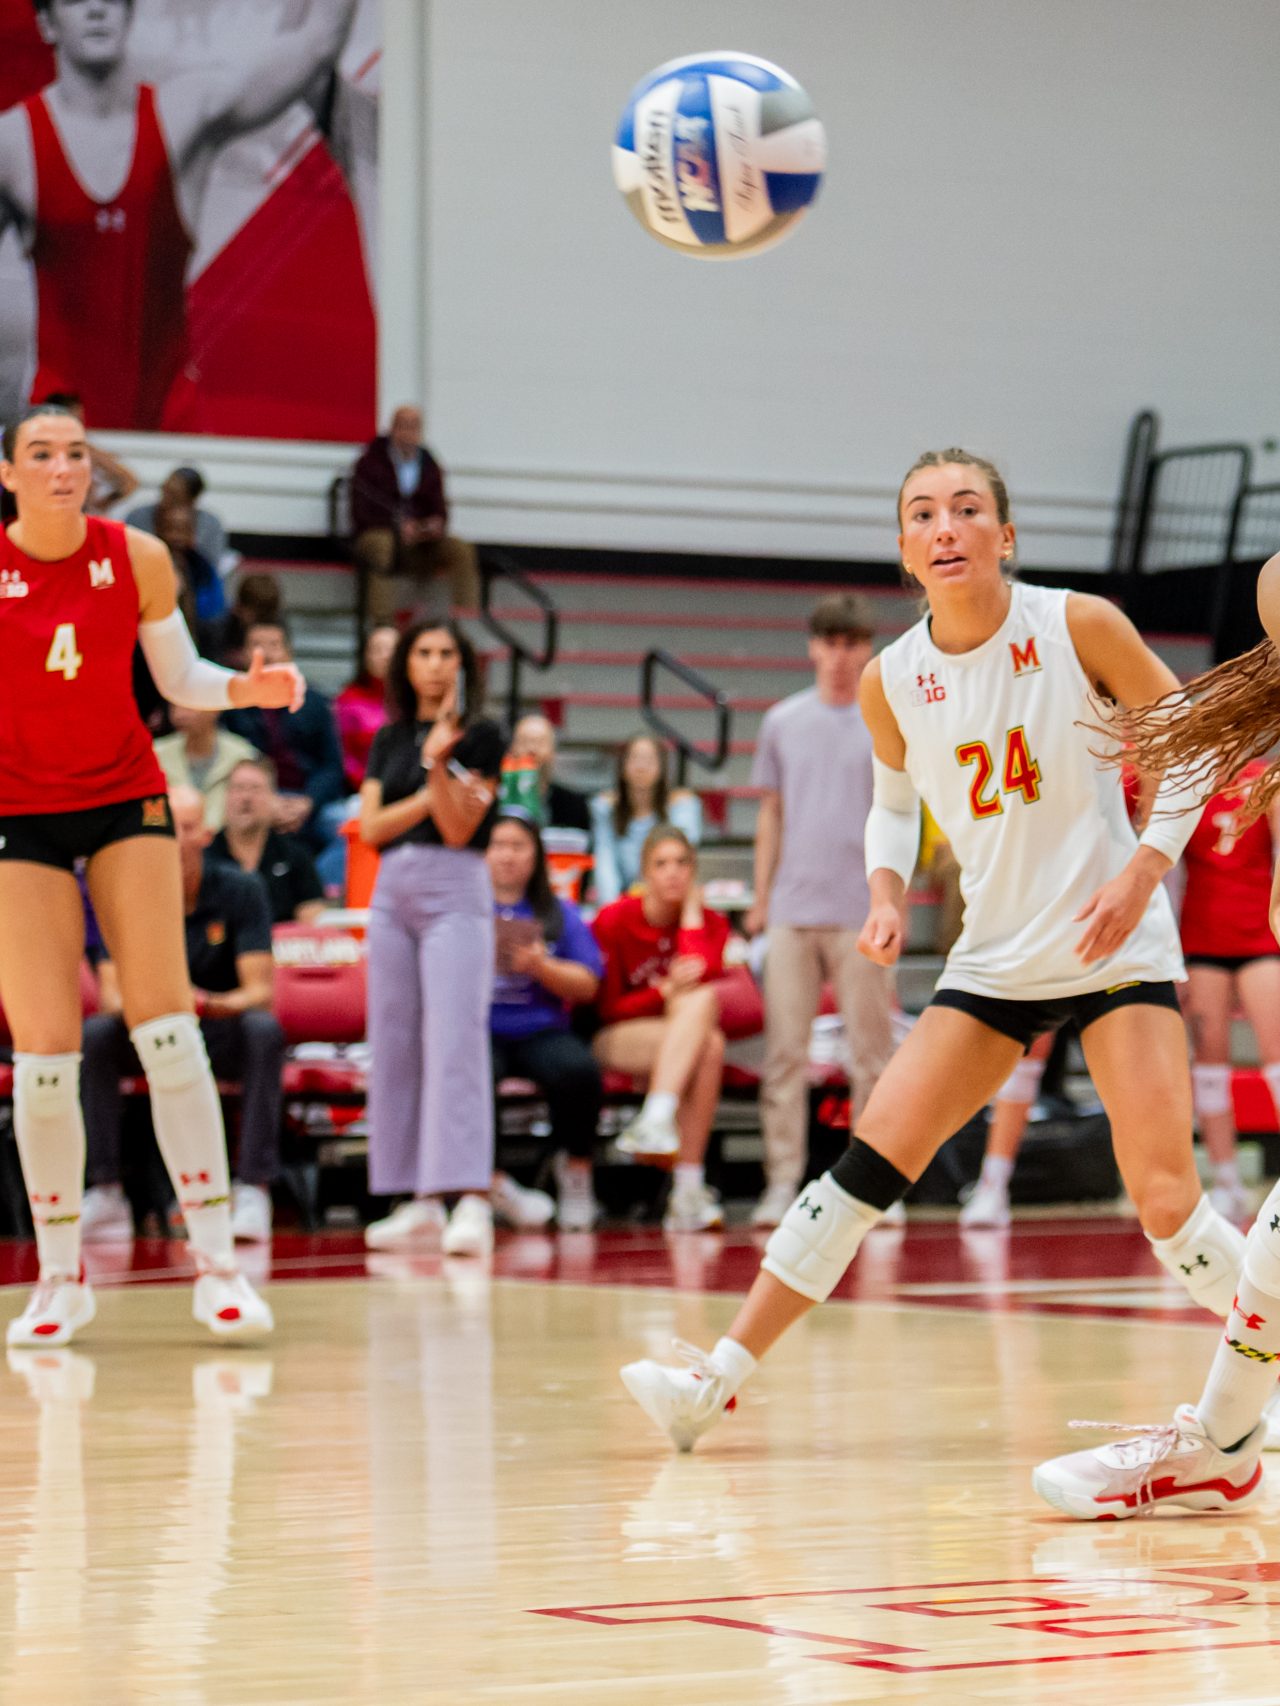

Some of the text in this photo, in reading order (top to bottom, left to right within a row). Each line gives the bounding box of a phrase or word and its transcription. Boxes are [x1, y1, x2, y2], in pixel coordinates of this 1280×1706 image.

[88, 558, 115, 588] M
[45, 622, 84, 681] 4
[1009, 637, 1041, 674] M
[955, 724, 1043, 822] 24
